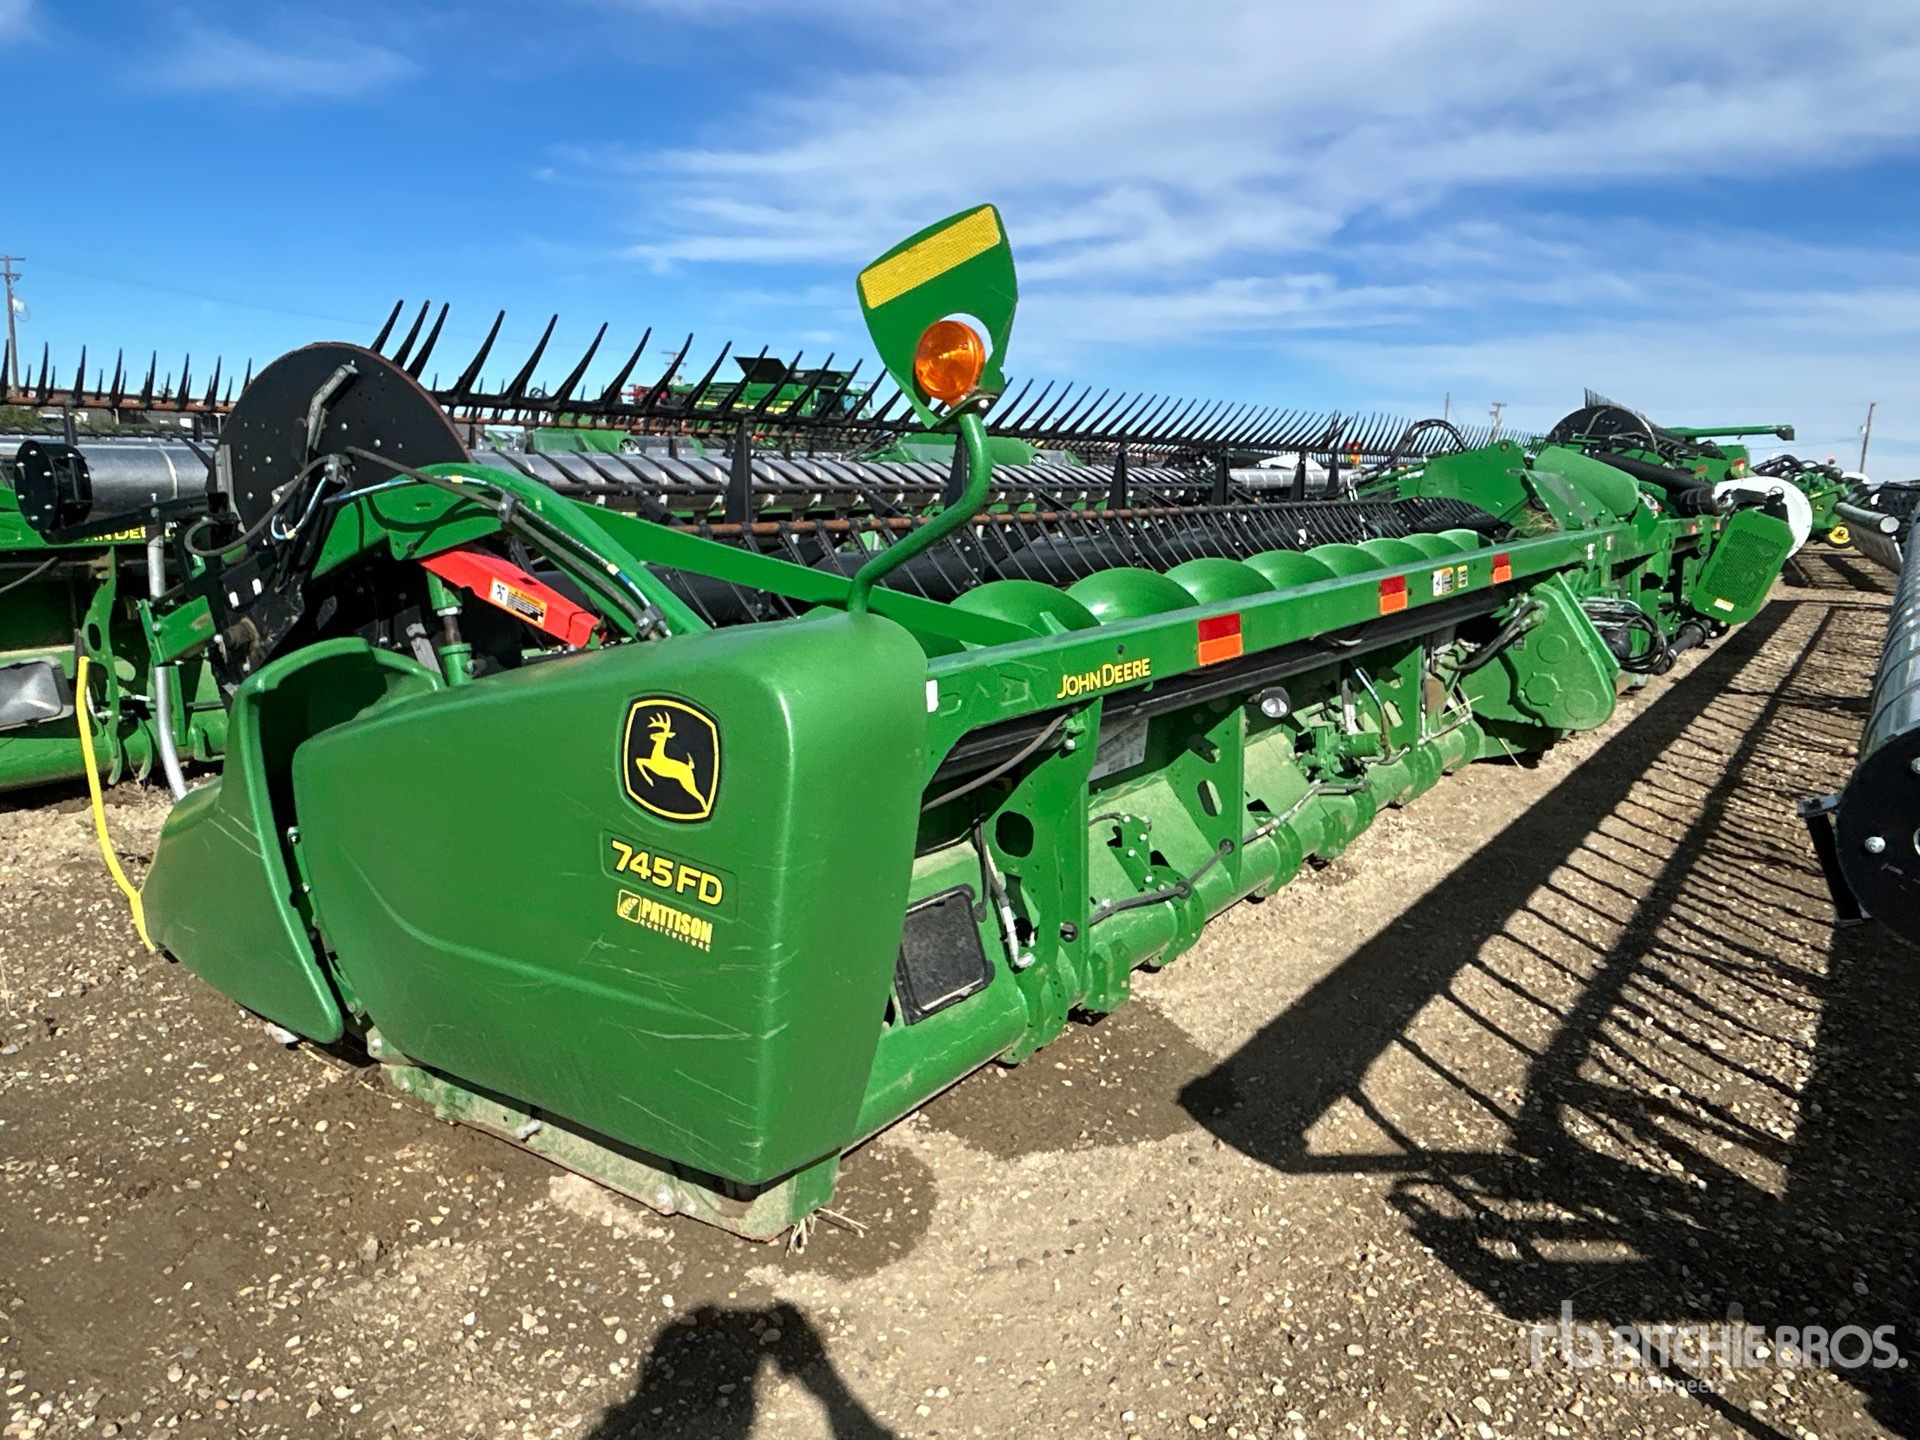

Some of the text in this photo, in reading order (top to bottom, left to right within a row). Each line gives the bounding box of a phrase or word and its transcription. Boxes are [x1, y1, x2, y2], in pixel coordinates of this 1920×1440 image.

[1057, 657, 1151, 699] JOHN DEERE
[640, 919, 711, 952] AGRICULTURE
[641, 897, 714, 944] PATTISON
